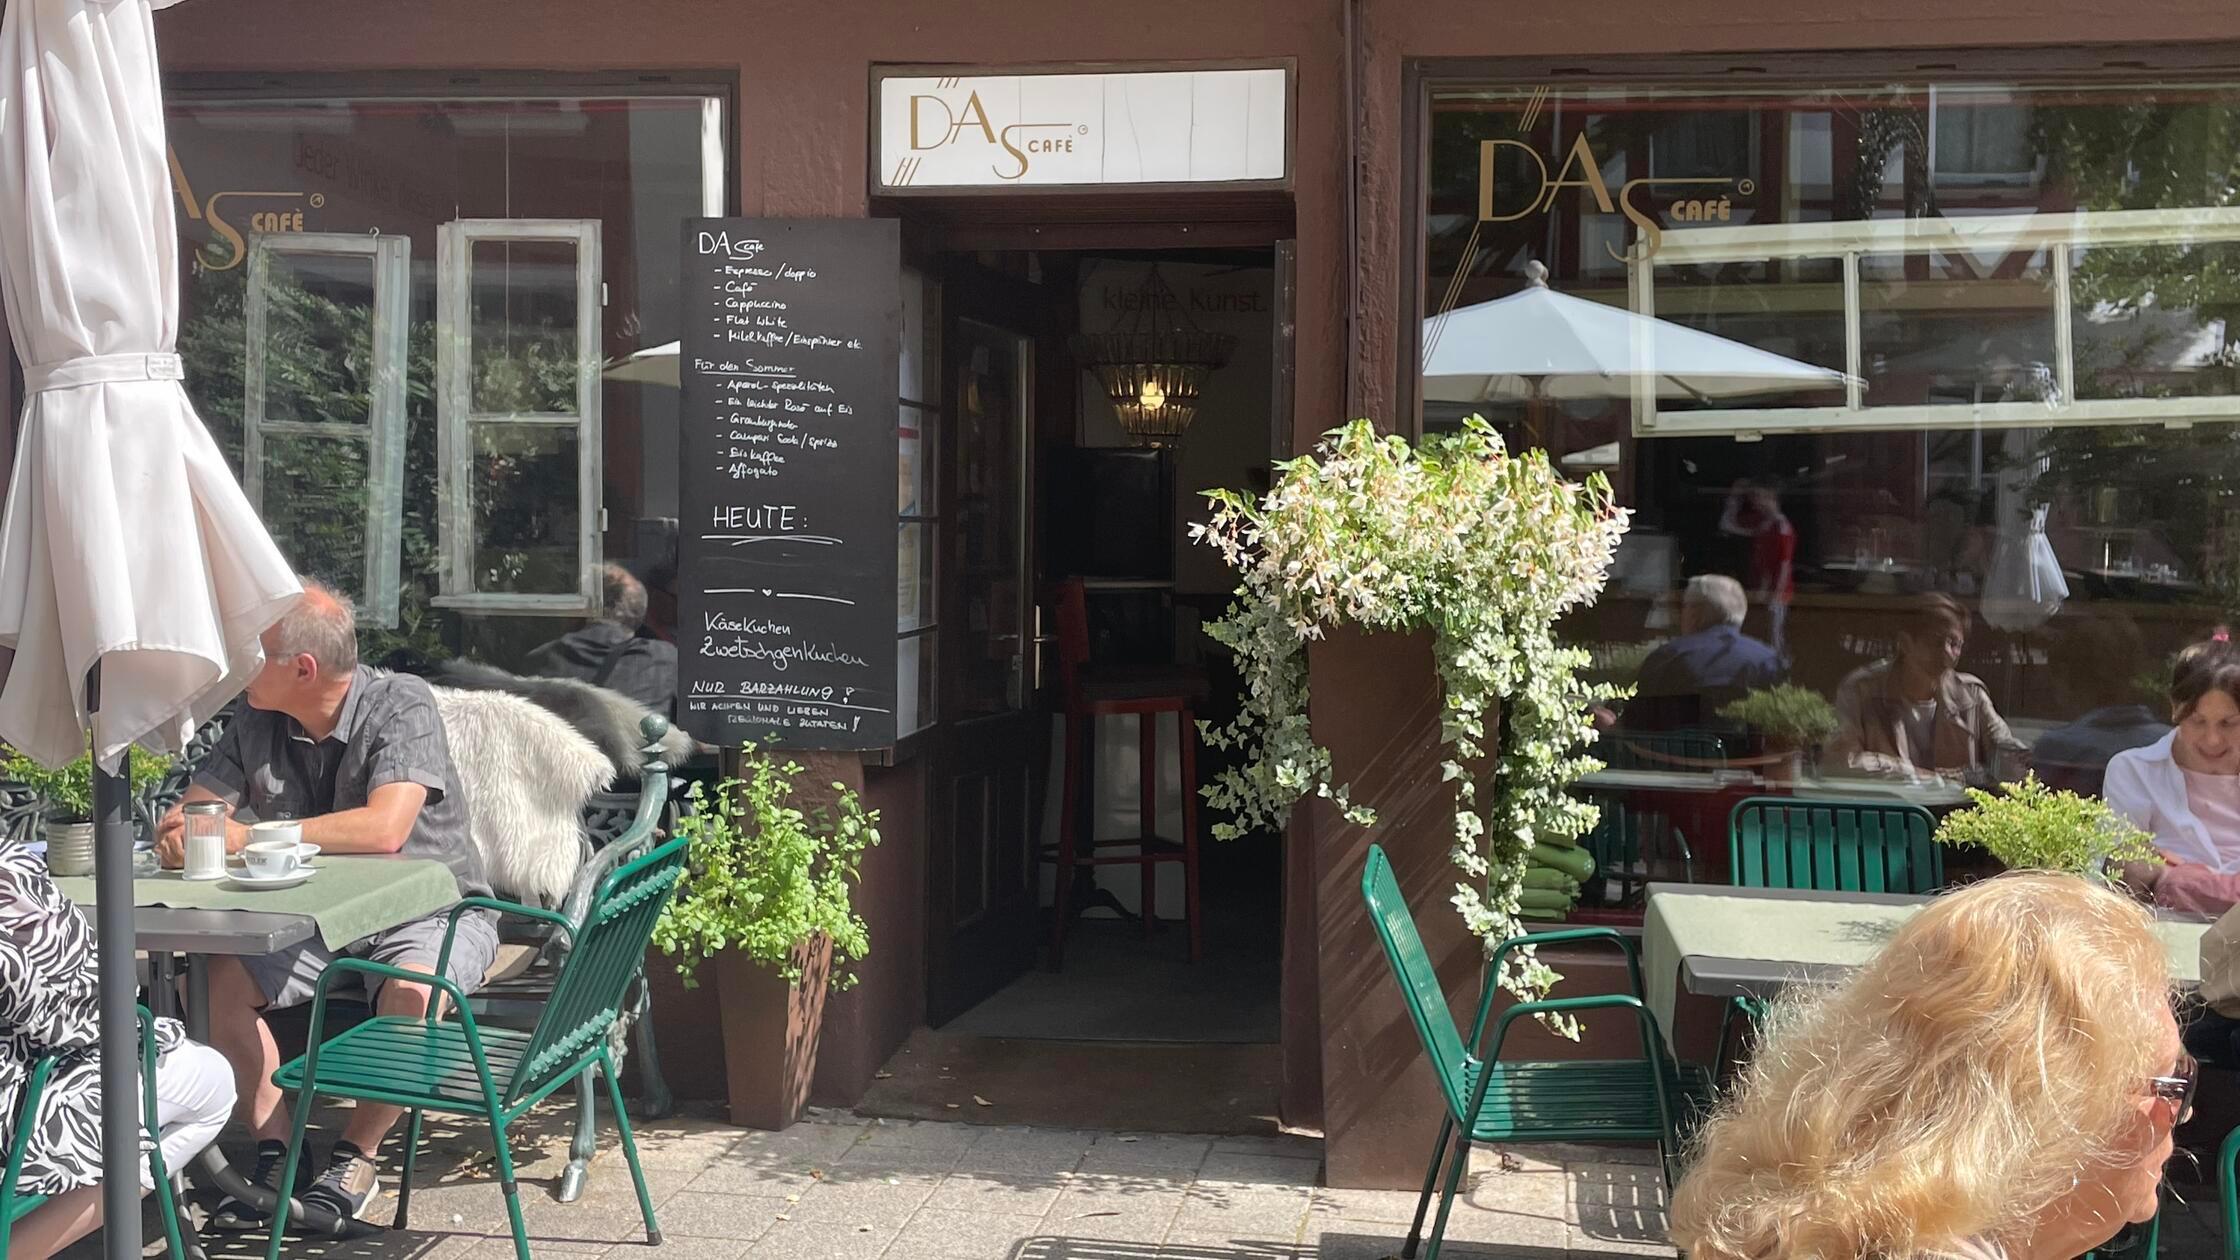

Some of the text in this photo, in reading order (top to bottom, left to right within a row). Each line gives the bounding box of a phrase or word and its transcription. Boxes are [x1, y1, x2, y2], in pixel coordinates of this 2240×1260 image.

[910, 89, 1072, 180] DAS
[1479, 131, 1733, 263] DAS
[698, 231, 760, 261] DAS
[725, 297, 787, 313] Cappuccino
[726, 315, 750, 325] Flat
[694, 358, 797, 373] Für den Sommer
[814, 402, 833, 417] auf
[838, 404, 853, 415] Eis
[728, 462, 779, 480] Affogato
[692, 681, 725, 694] NUR
[757, 704, 780, 713] UND
